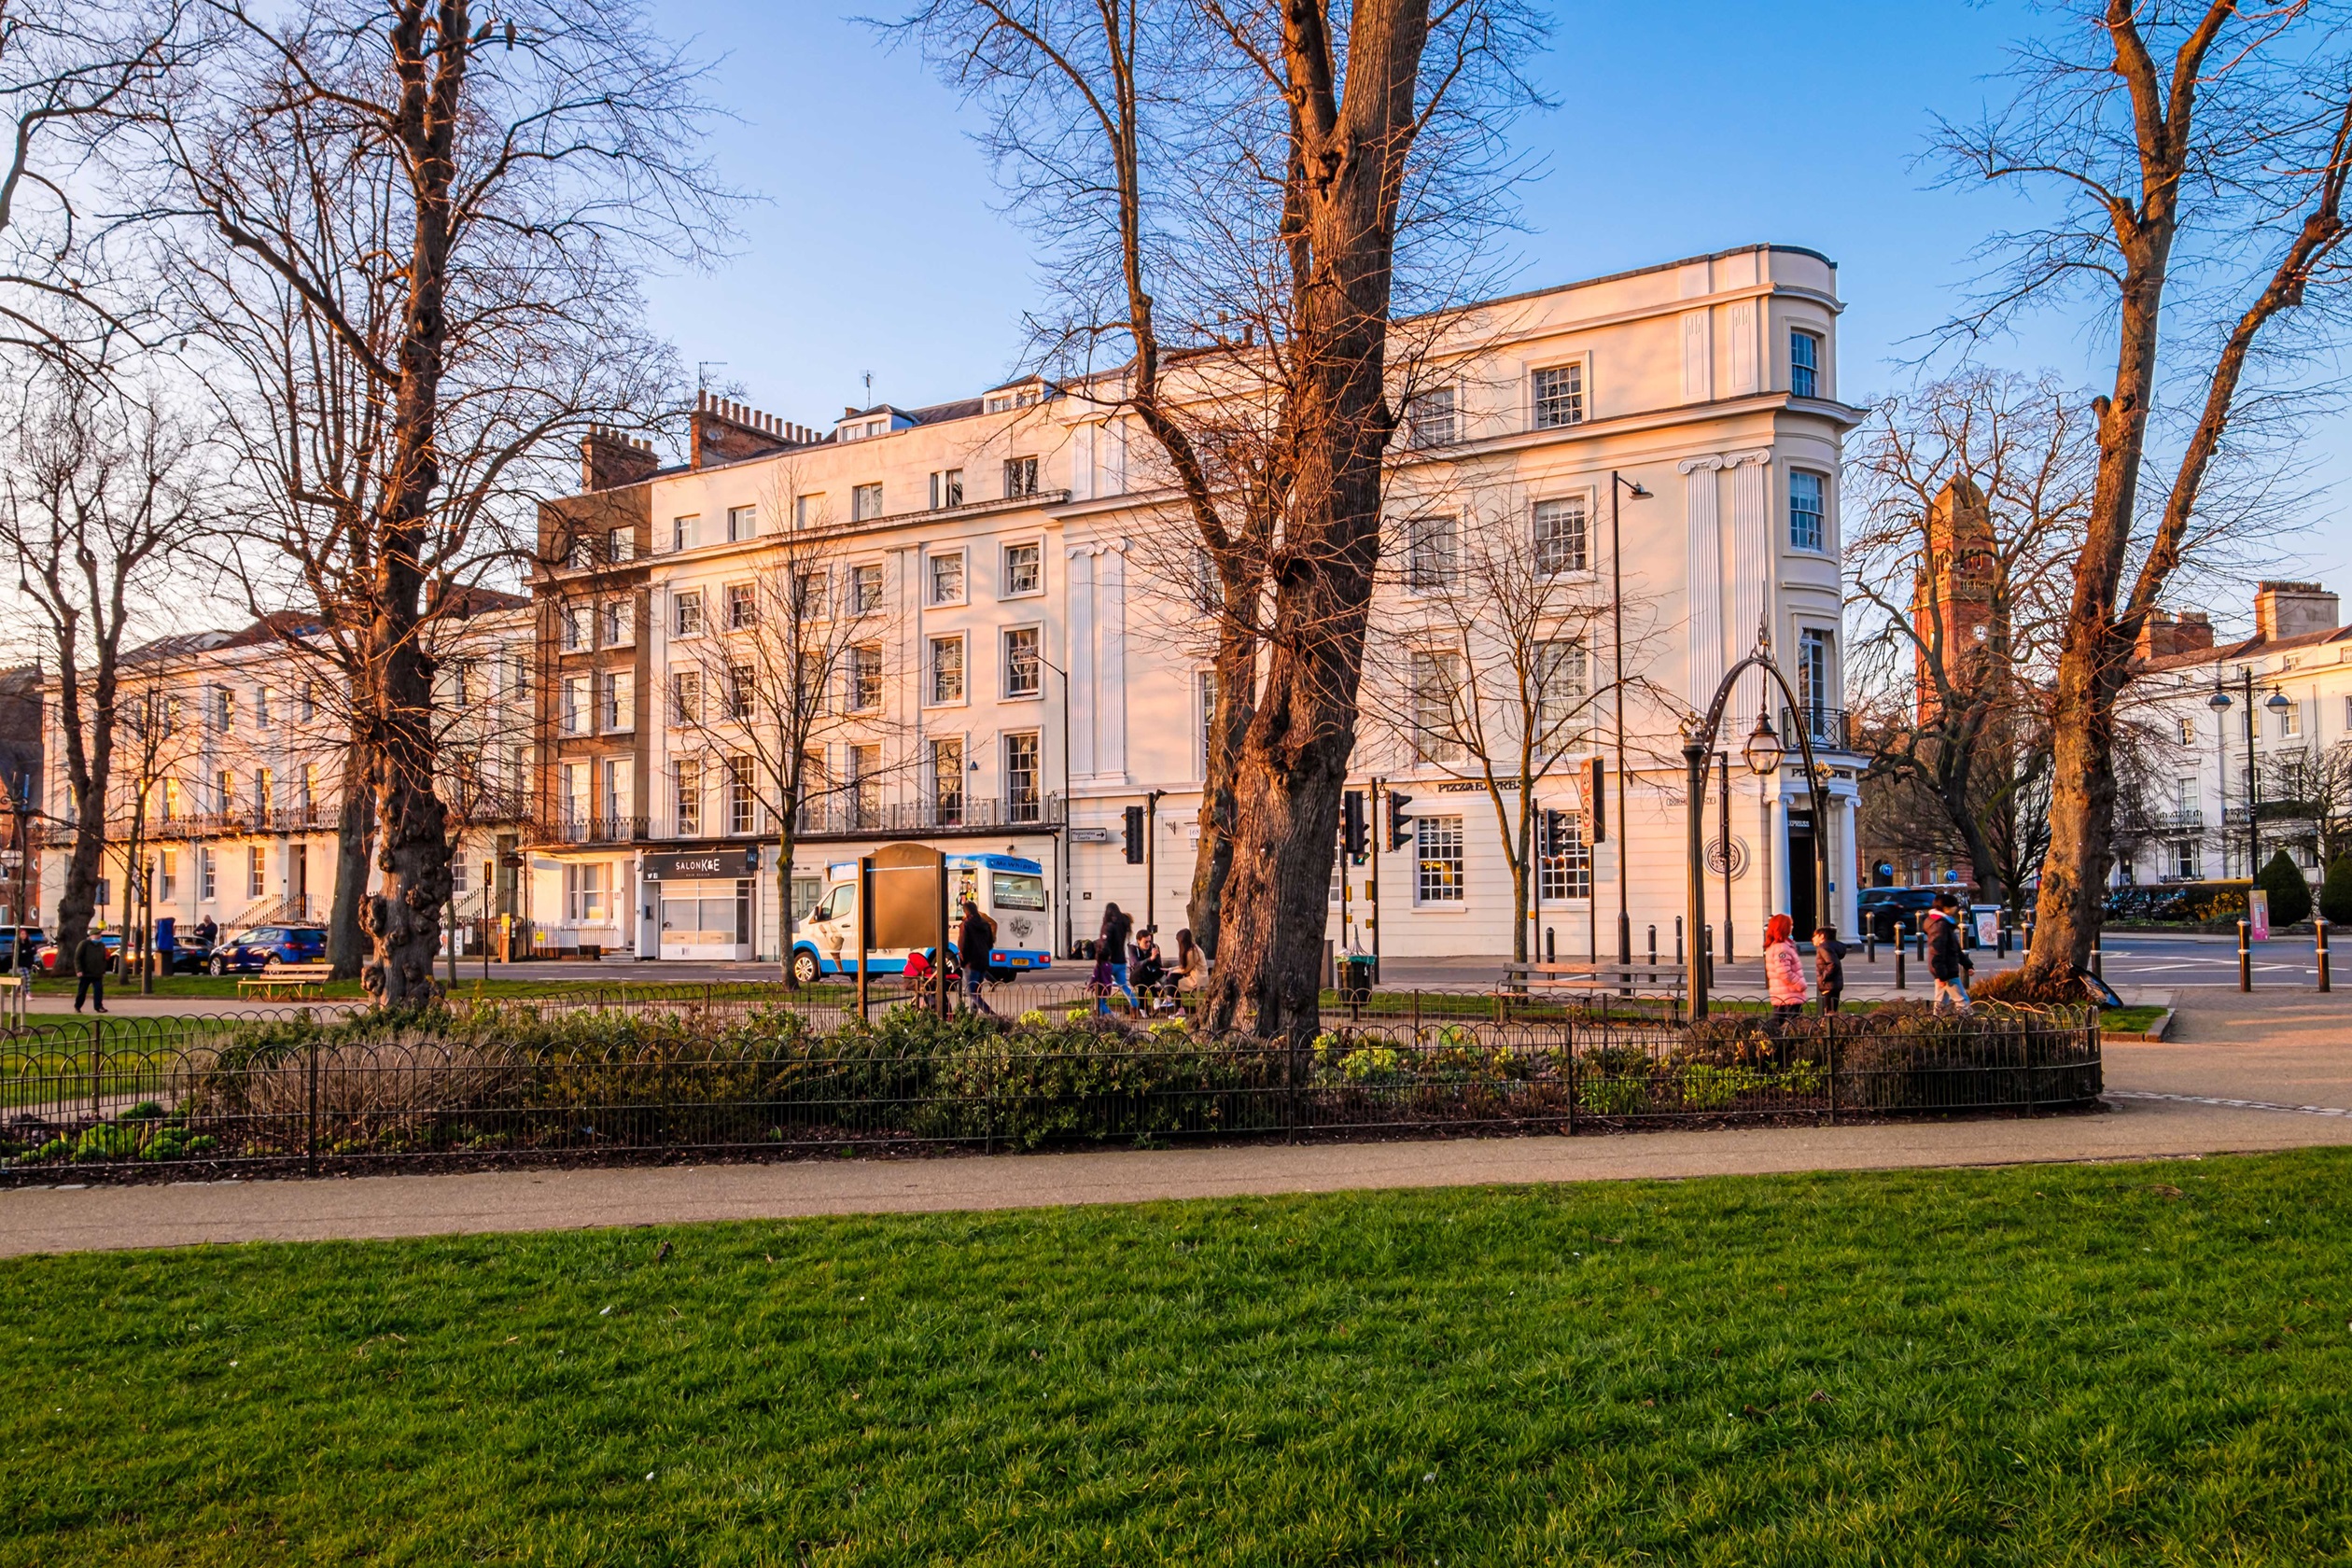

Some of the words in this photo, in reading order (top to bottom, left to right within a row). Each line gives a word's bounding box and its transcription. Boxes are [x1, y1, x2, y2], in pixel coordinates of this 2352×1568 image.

[1438, 782, 1474, 792] PIZZA
[1475, 779, 1523, 791] EPRES
[676, 861, 701, 870] SALON
[701, 859, 720, 872] K&E
